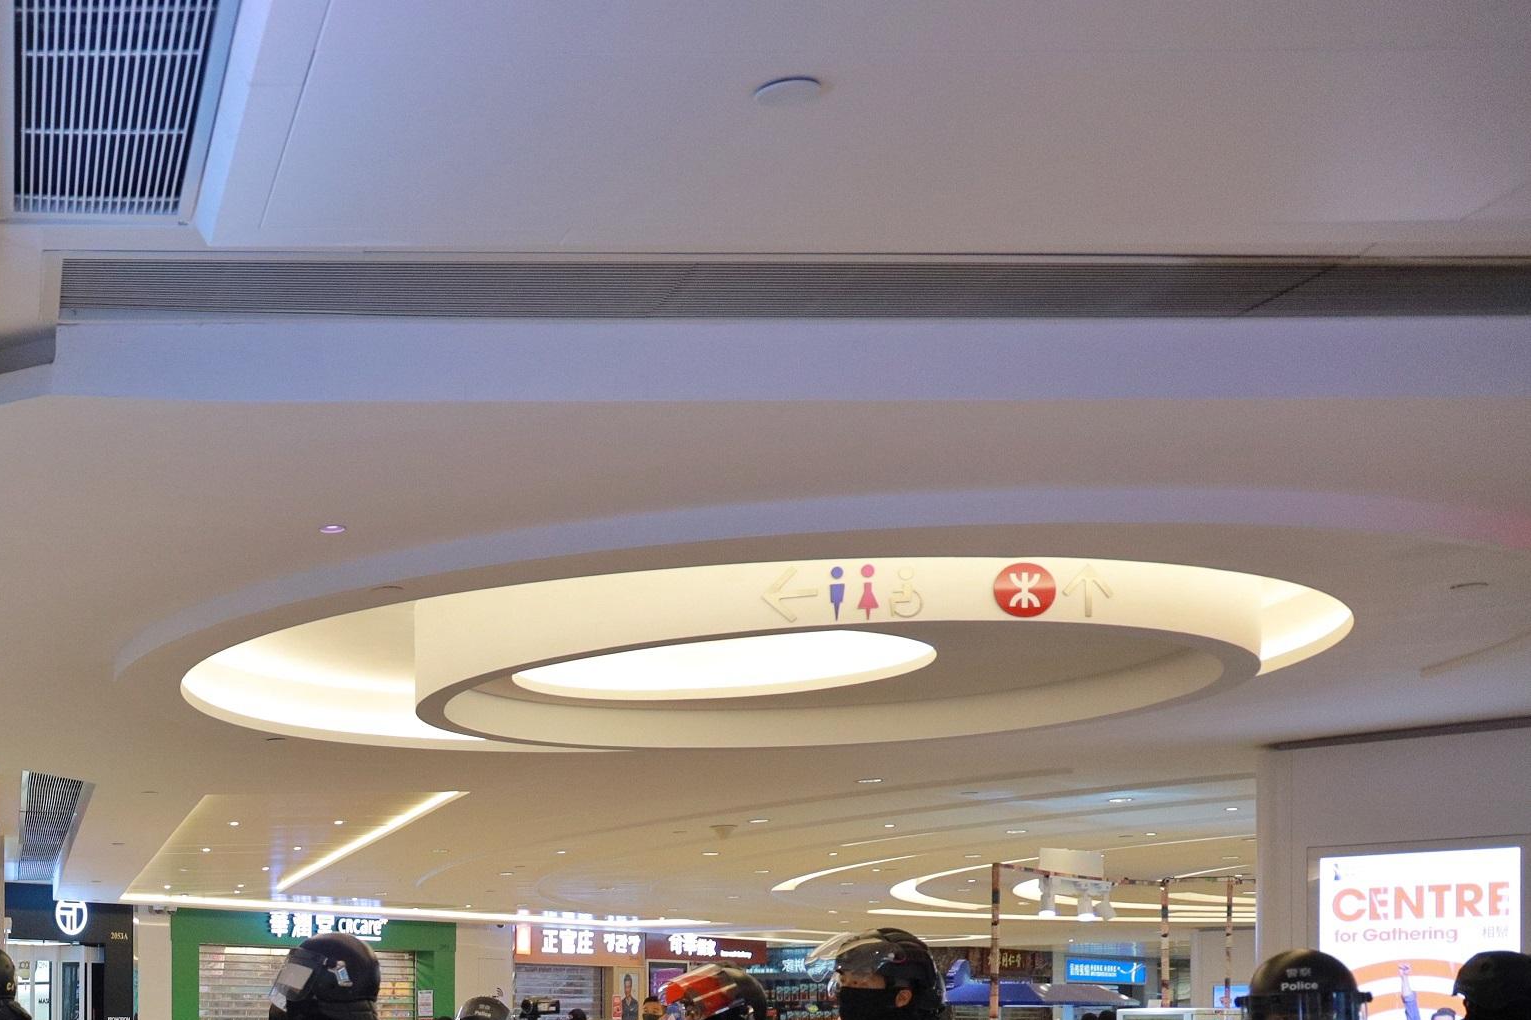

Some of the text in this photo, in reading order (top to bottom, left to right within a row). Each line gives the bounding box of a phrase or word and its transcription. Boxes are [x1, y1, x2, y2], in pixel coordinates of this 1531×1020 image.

[1332, 881, 1509, 922] CENTRE
[111, 931, 129, 940] 2053A
[1334, 926, 1458, 943] for Gathering
[1280, 980, 1319, 992] Police
